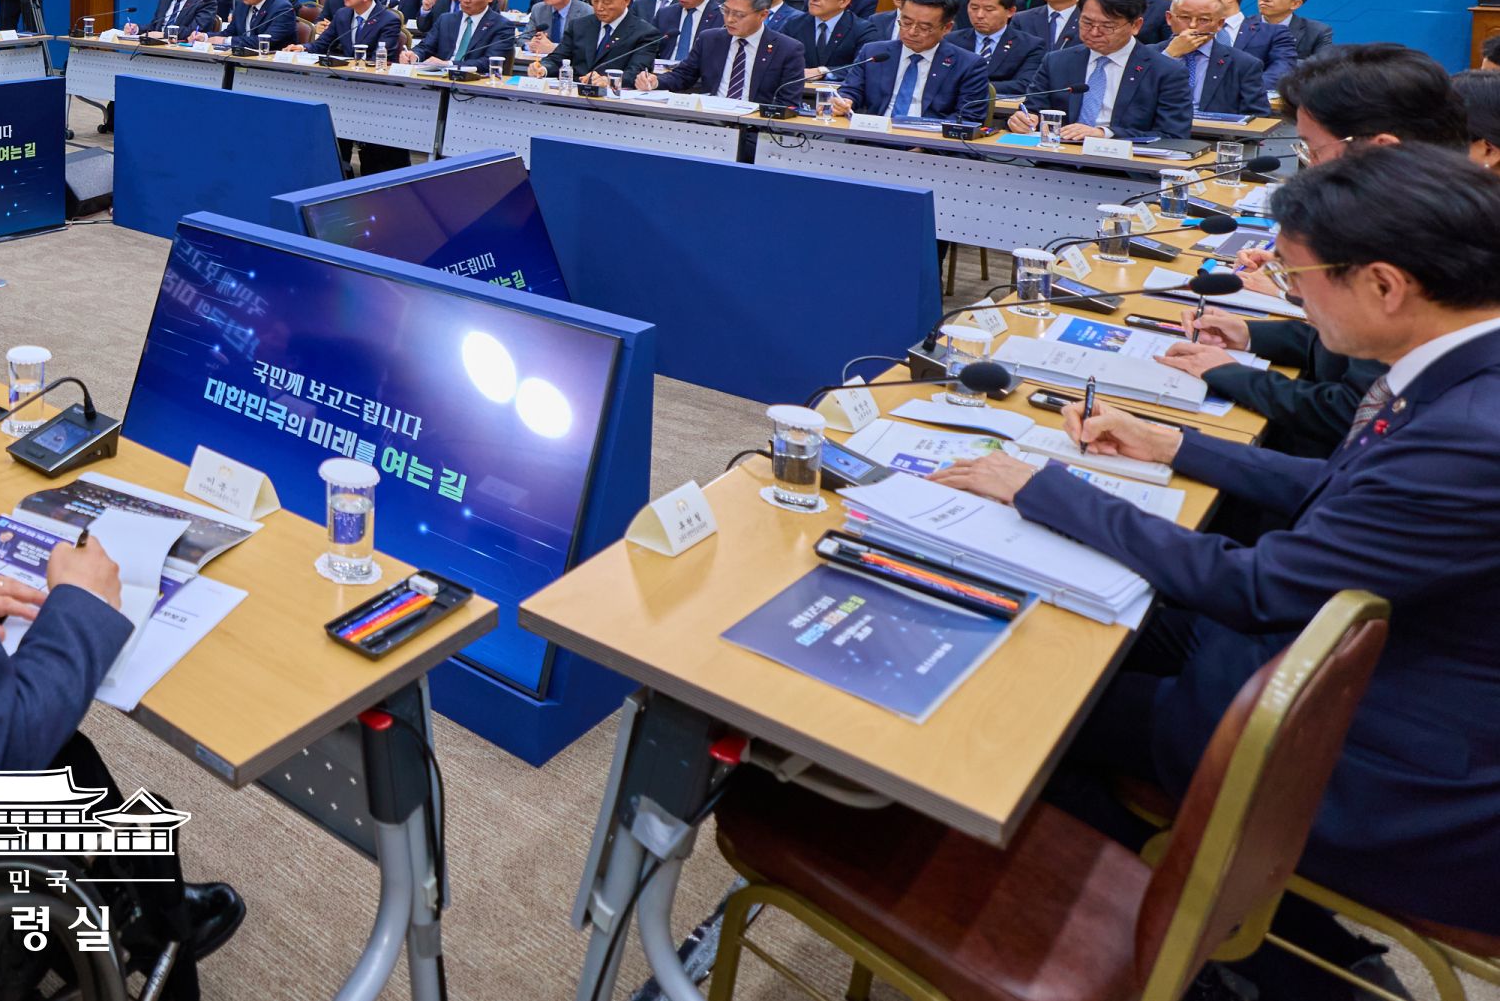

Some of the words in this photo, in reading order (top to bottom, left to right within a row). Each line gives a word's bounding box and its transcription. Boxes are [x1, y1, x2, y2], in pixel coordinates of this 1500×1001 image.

[24, 142, 36, 158] 길
[511, 269, 526, 289] 길
[252, 360, 305, 397] 국민께
[306, 379, 423, 441] 보고드립니다
[203, 377, 306, 438] 대한민국의
[307, 417, 376, 467] 미래를
[380, 446, 434, 490] 여는
[438, 467, 467, 503] 길
